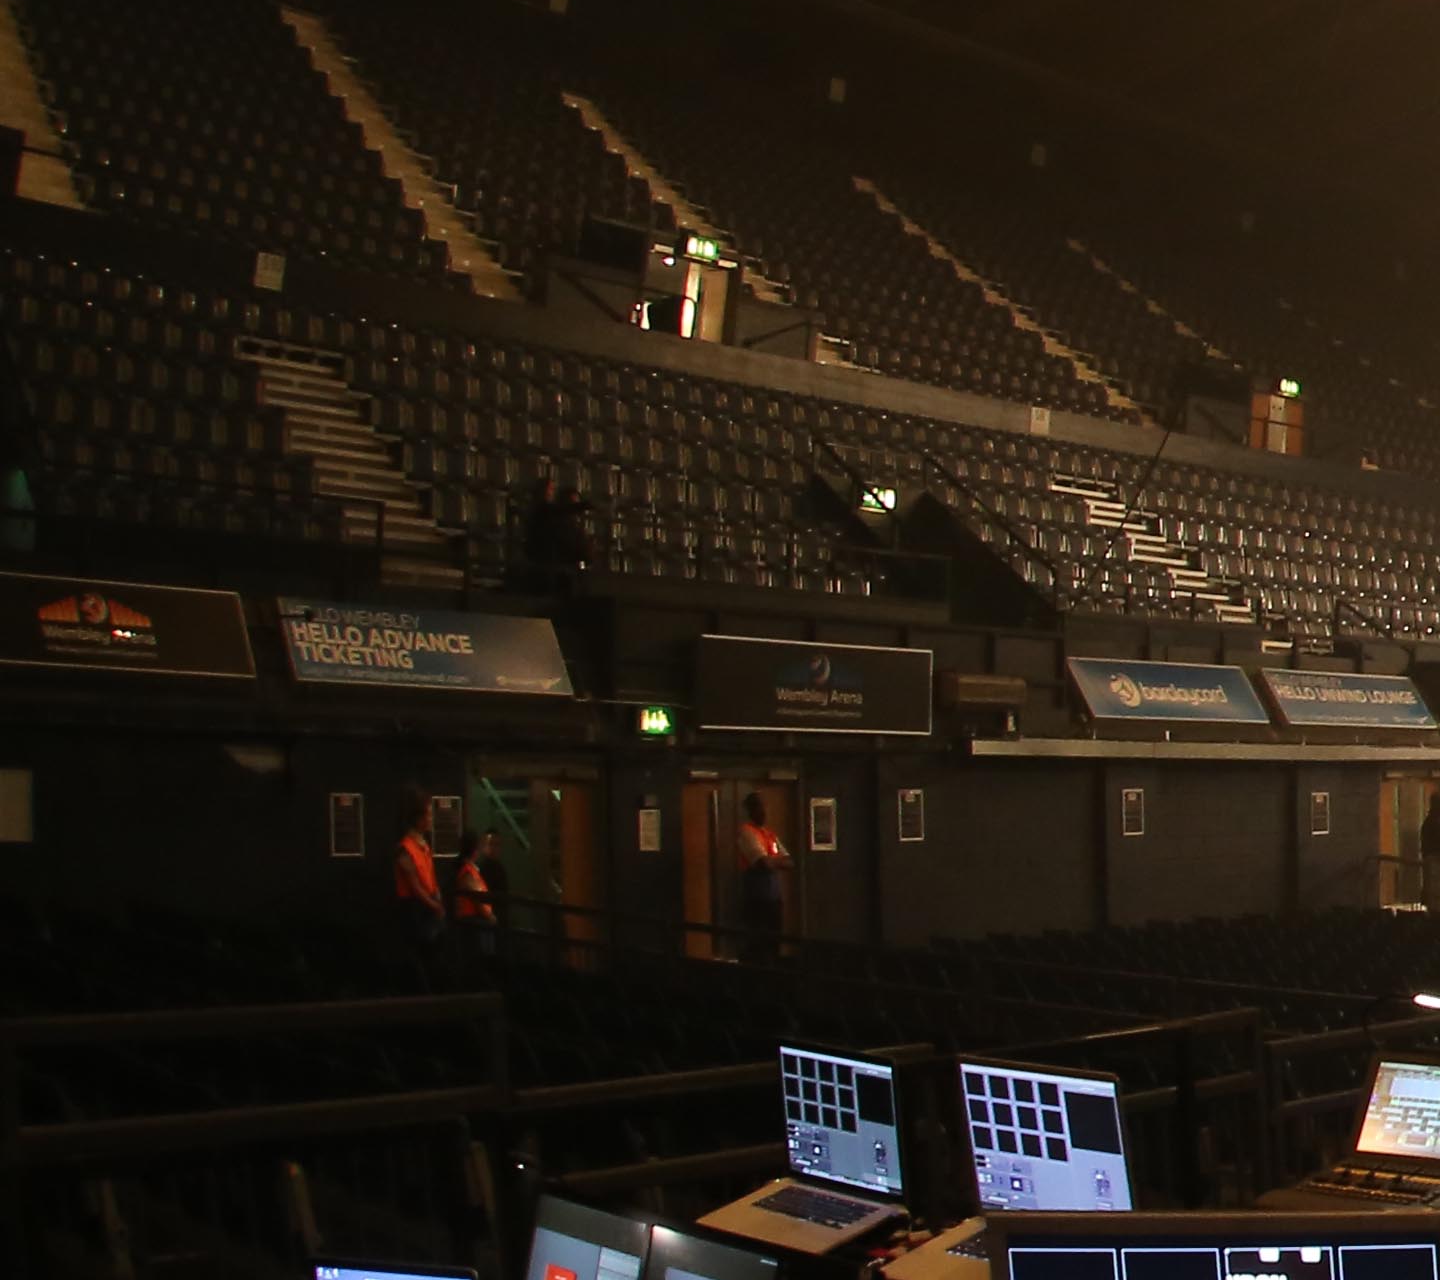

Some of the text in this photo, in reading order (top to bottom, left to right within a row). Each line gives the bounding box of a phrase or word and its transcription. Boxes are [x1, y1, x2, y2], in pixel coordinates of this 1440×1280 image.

[290, 621, 474, 655] HELLO ADVANCE
[293, 641, 414, 670] TICKETING
[775, 686, 864, 707] Wembley Arena
[1140, 680, 1229, 706] barclaycard
